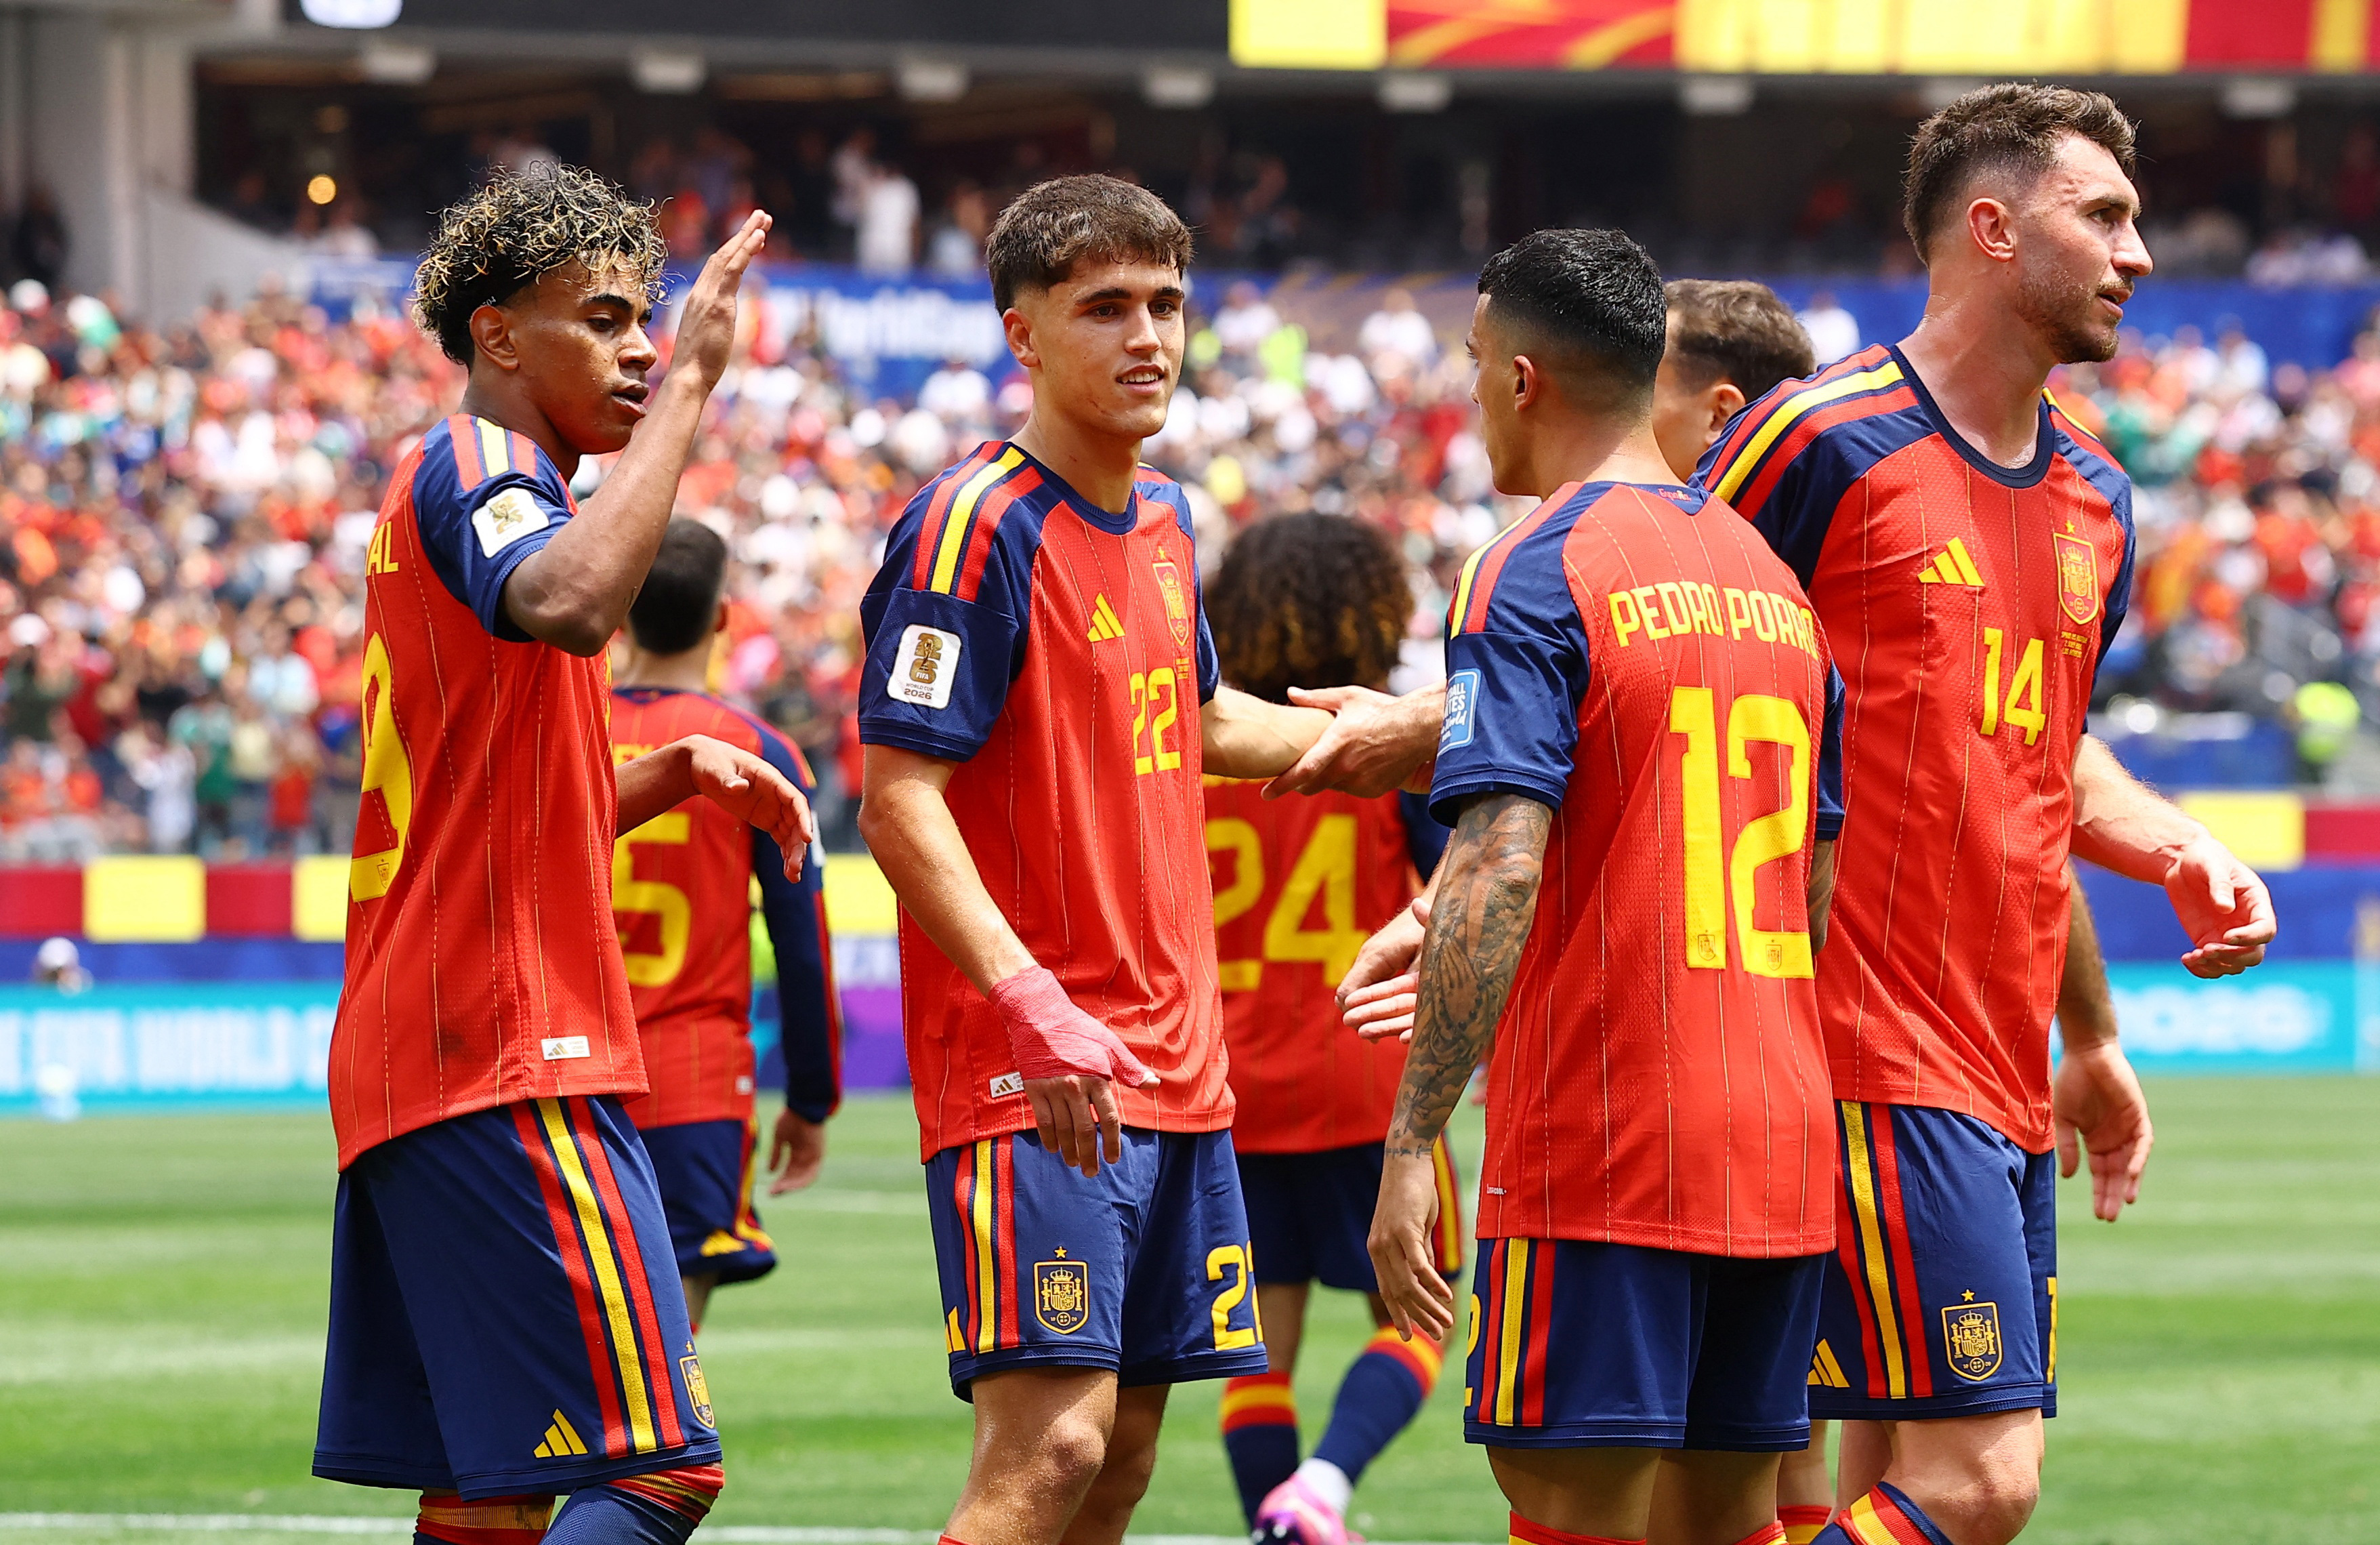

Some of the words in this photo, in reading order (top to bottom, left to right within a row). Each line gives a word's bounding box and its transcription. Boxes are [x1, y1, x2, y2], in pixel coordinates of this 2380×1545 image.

[366, 521, 398, 577] AL
[1608, 581, 1724, 648] PEDRO
[1723, 588, 1819, 660] PORRO
[904, 688, 932, 699] 2026
[916, 672, 930, 680] FIFA
[1130, 667, 1181, 775] 22
[1980, 627, 2046, 746] 14
[1669, 686, 1815, 979] 12
[1205, 815, 1370, 991] 24
[1206, 1239, 1264, 1352] 2
